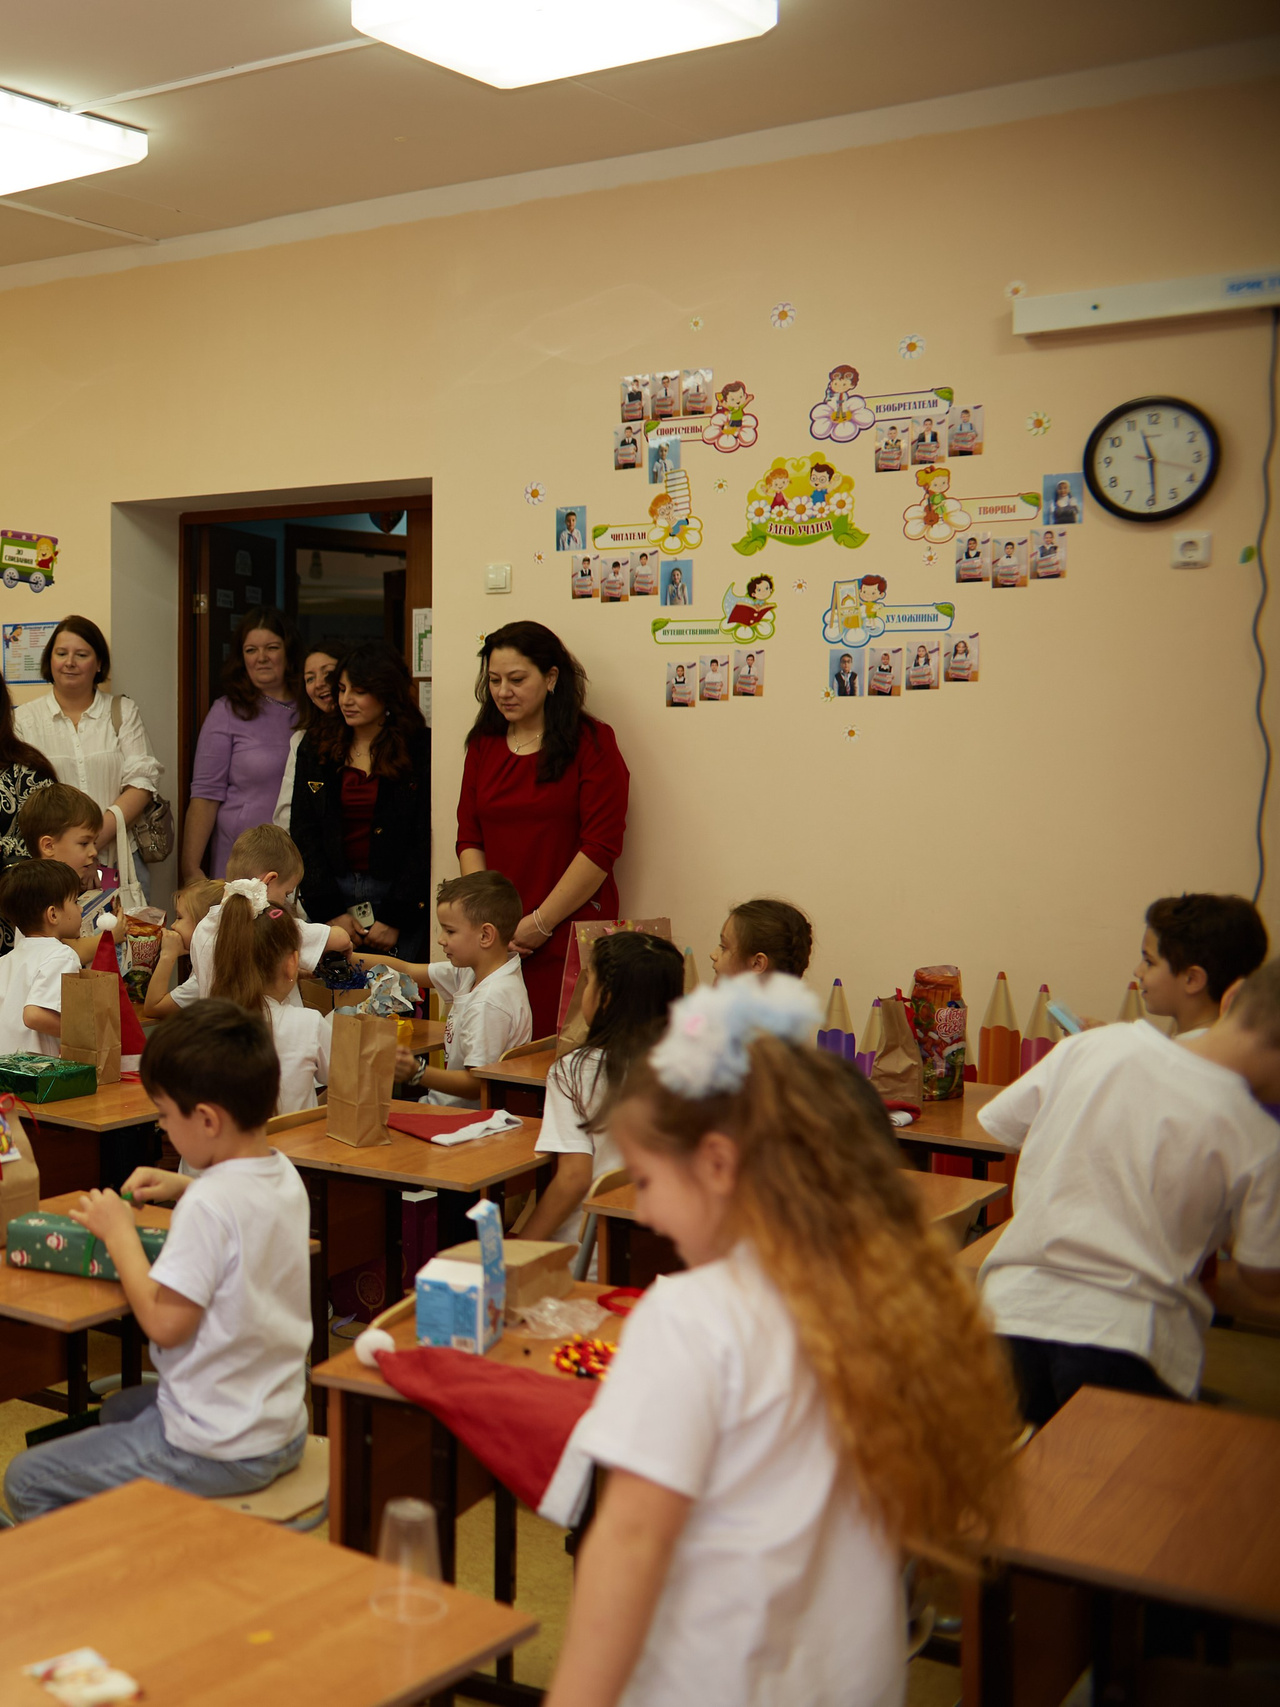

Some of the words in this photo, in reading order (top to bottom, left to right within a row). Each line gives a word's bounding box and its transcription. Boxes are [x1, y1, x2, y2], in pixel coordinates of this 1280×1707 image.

[875, 399, 938, 413] ИЗОБРЕТАТЕЛИ
[1126, 419, 1137, 432] 11
[1147, 412, 1161, 426] 12
[1173, 415, 1180, 428] 1
[656, 425, 703, 436] СПОРТСМЕНЫ
[1186, 430, 1198, 443] 2
[1108, 435, 1123, 448] 10
[1103, 456, 1113, 468] 9
[1192, 450, 1203, 464] 3
[1108, 476, 1118, 488] 8
[1185, 472, 1196, 484] 4
[1123, 489, 1134, 504] 7
[1145, 494, 1156, 507] 6
[1168, 487, 1179, 501] 5
[978, 504, 1017, 515] ТВОРЦЫ
[767, 521, 795, 536] ЗДЕСЬ
[798, 520, 833, 536] УЧАТСЯ
[610, 531, 647, 541] ЧИТАТЕЛИ
[885, 613, 939, 624] ХУДОЖНИКИ
